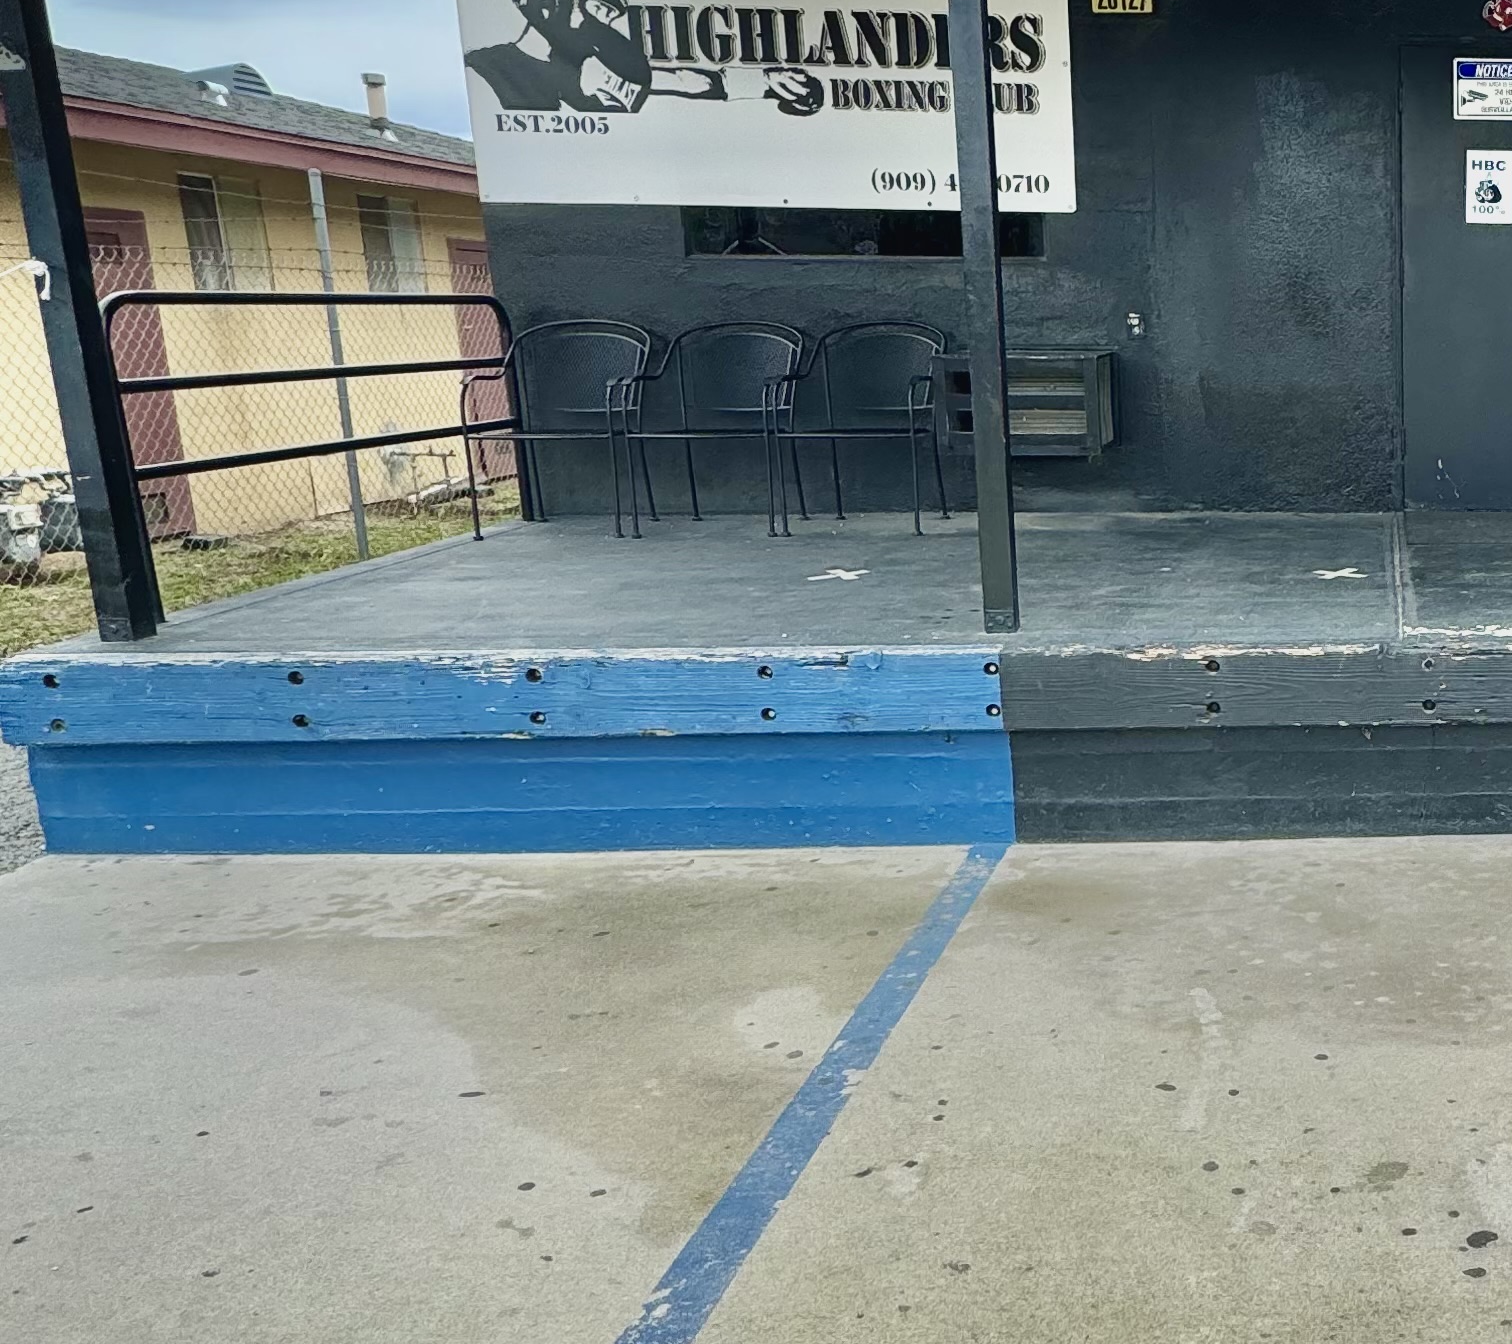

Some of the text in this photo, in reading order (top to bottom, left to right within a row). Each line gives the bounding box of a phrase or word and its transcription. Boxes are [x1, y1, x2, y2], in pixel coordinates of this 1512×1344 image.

[829, 78, 1041, 116] BOXING UB
[495, 112, 610, 136] EST.2005
[1471, 160, 1506, 171] HBC
[871, 167, 936, 195] (909)
[1472, 205, 1506, 215] 100%
